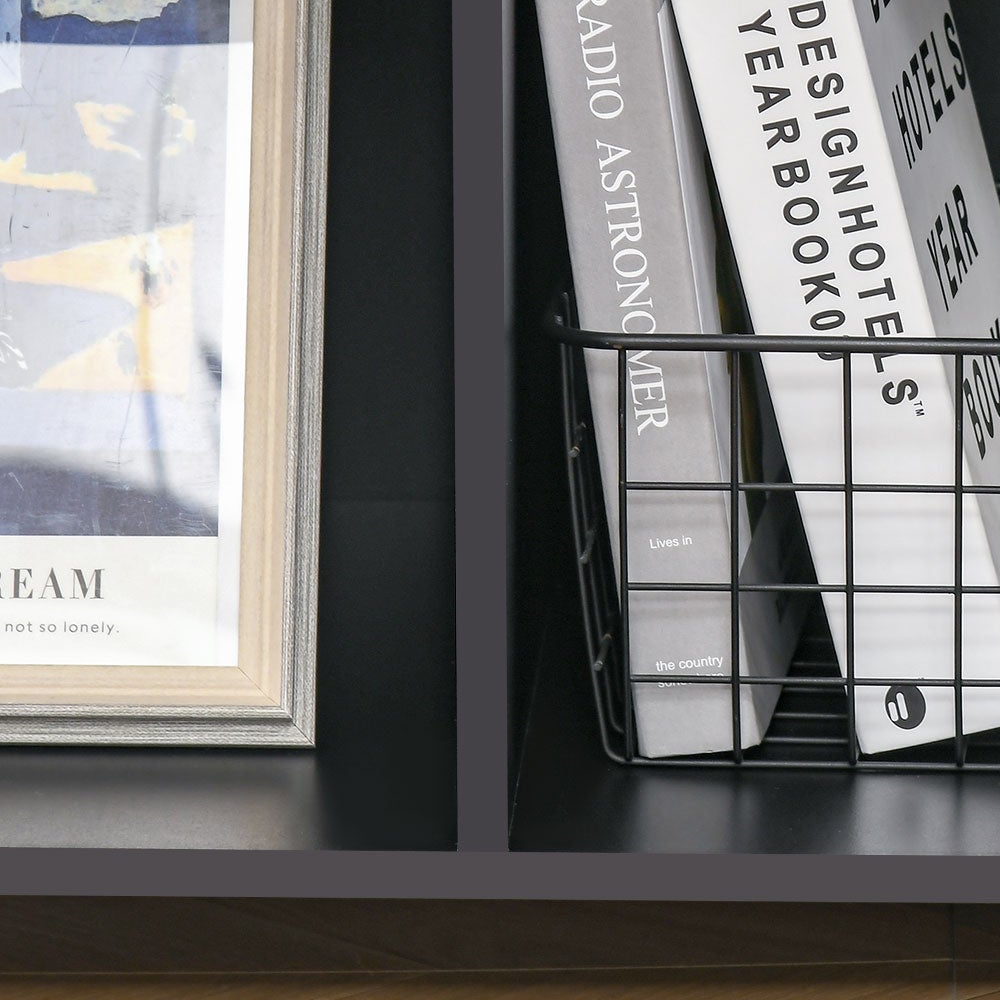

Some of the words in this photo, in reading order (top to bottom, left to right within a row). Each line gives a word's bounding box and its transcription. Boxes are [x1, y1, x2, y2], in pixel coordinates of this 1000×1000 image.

[891, 12, 967, 170] HOTELS
[926, 183, 980, 312] YEAR
[595, 138, 670, 437] ASTRONOMER
[649, 537, 680, 549] Lives
[681, 534, 693, 546] in
[0, 567, 105, 600] EAM
[5, 621, 33, 633] not
[39, 623, 57, 633] so
[63, 621, 120, 636] lonely.
[655, 660, 675, 672] the
[678, 655, 724, 670] country
